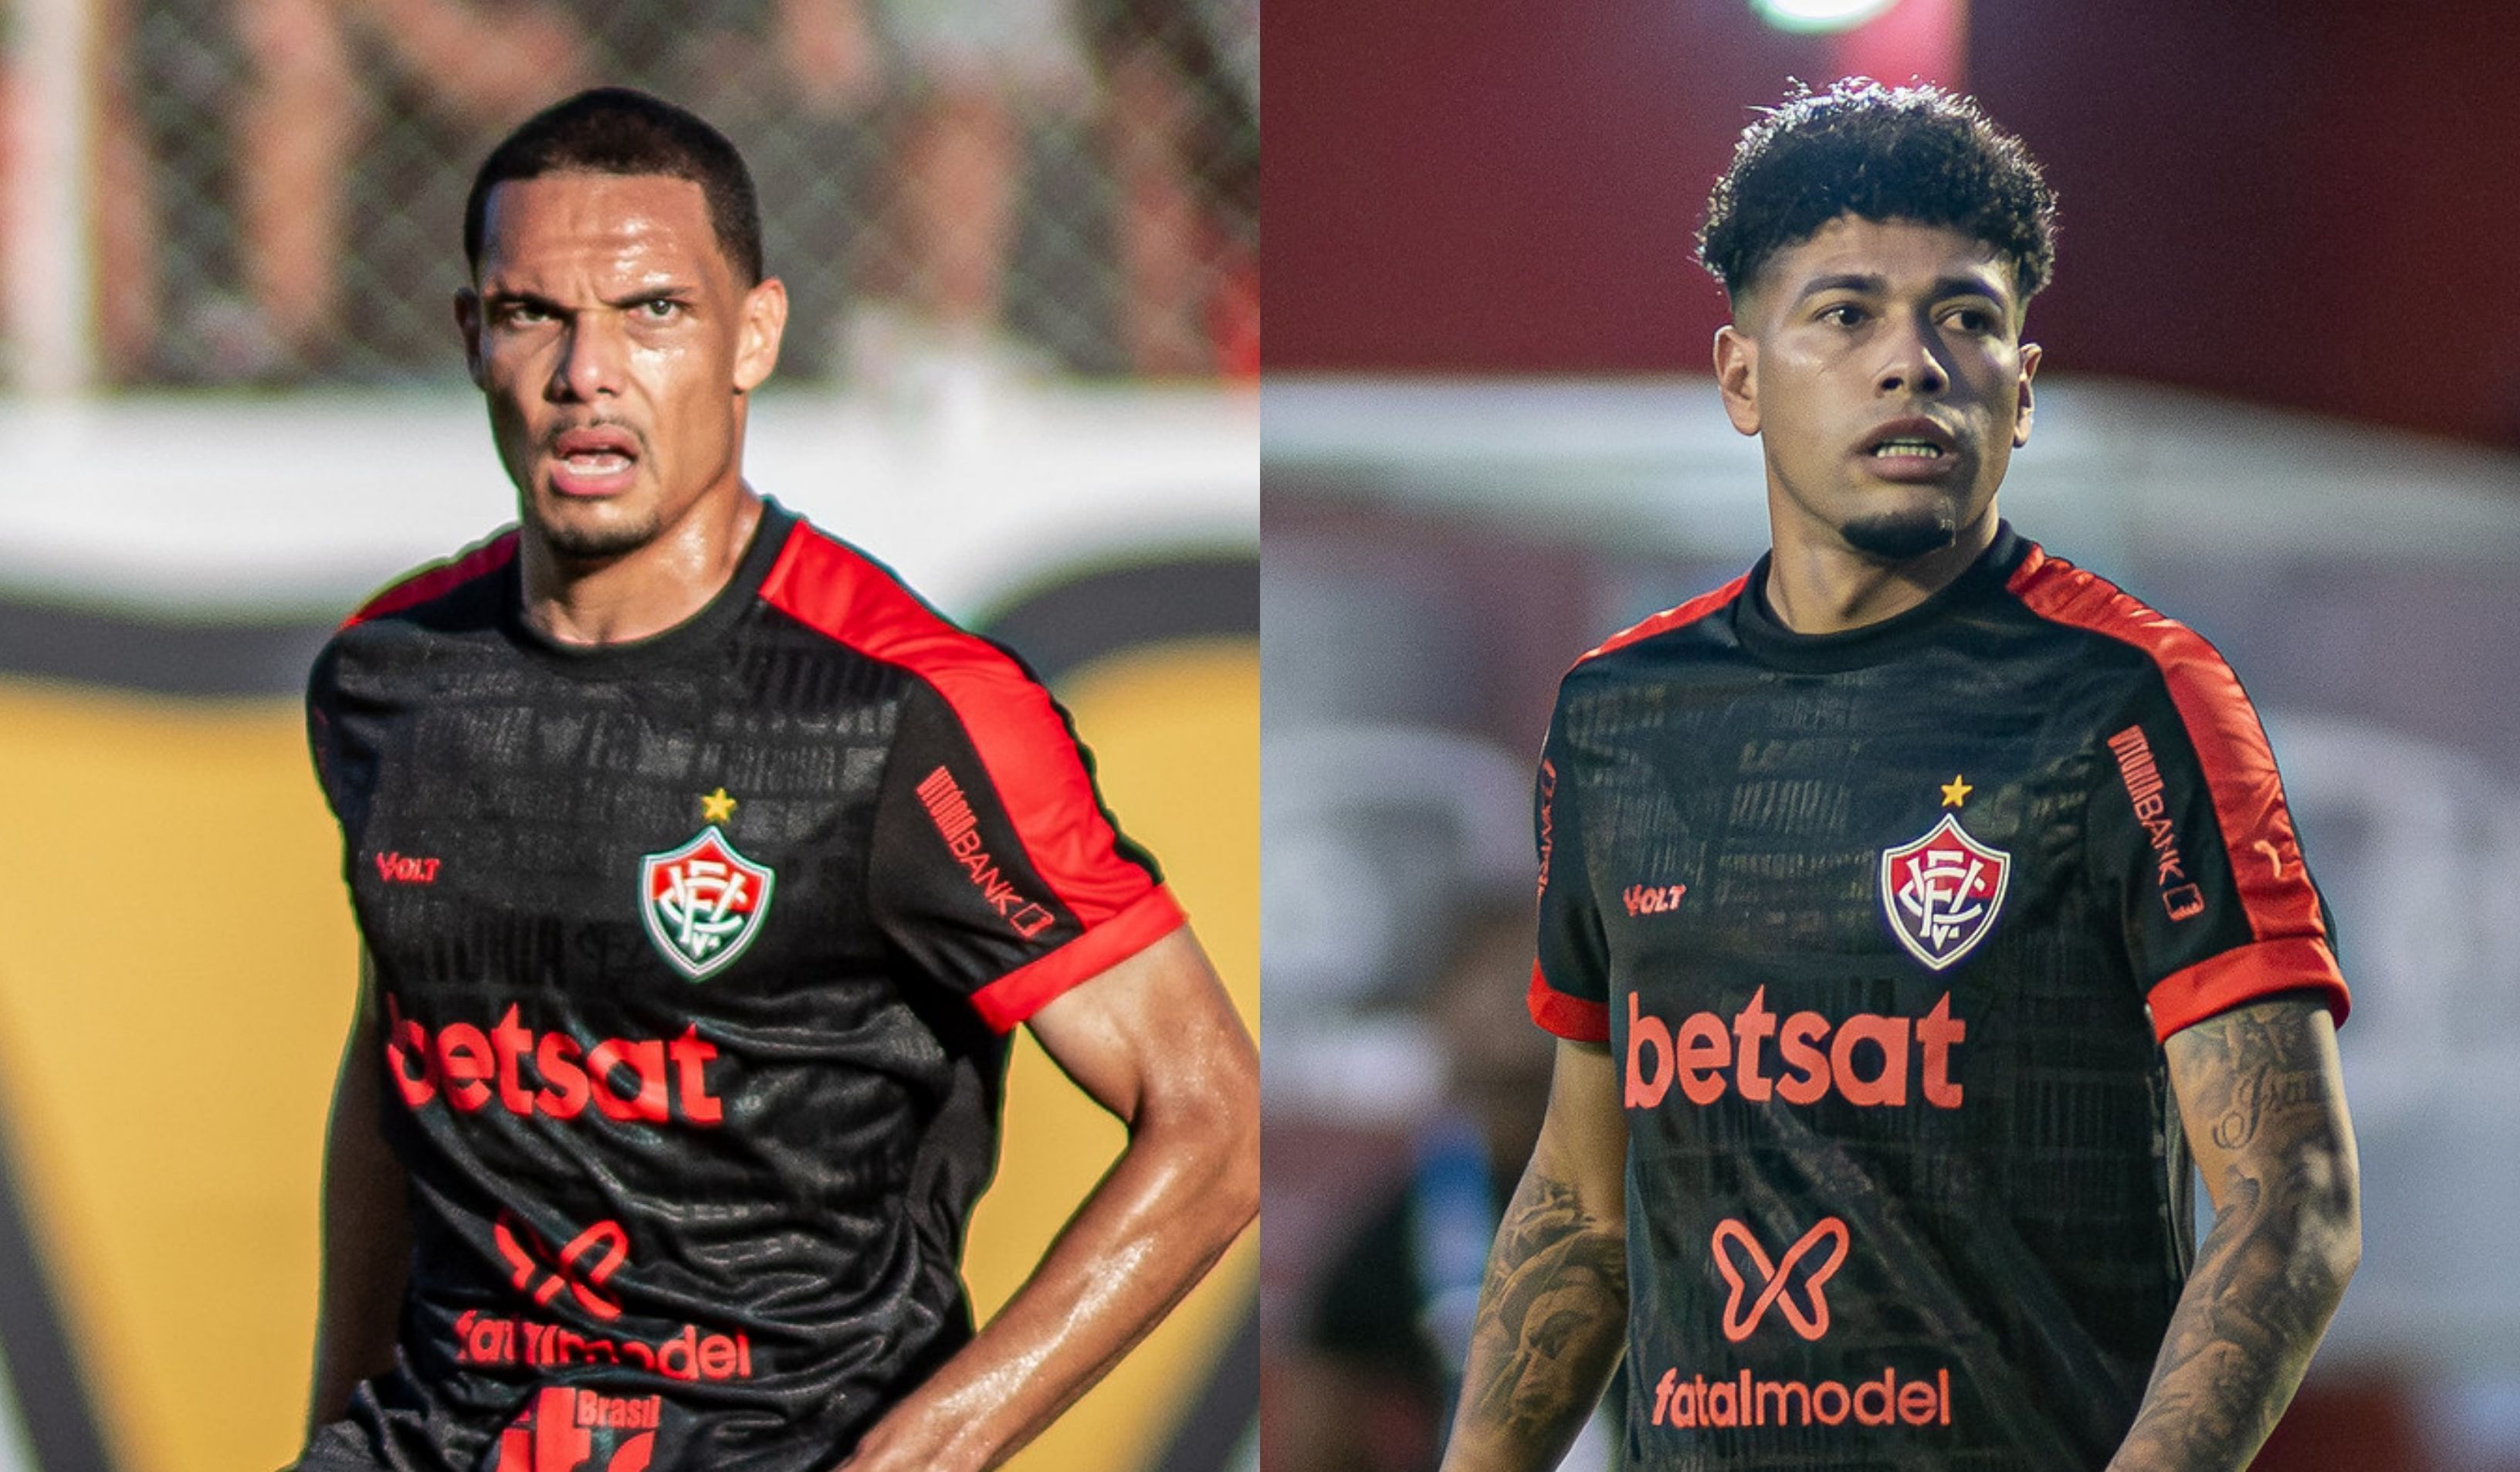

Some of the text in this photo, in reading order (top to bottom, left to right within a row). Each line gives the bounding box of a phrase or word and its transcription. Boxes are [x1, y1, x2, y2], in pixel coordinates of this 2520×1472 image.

[376, 852, 440, 882] VOLT
[950, 828, 1023, 917] BANK
[2132, 792, 2185, 887] BANK
[1624, 884, 1686, 917] VOLT
[388, 992, 723, 1125] betsat
[1624, 984, 1966, 1110] betsat
[578, 1389, 661, 1428] Brasil
[1651, 1366, 1951, 1428] fatalmodel
